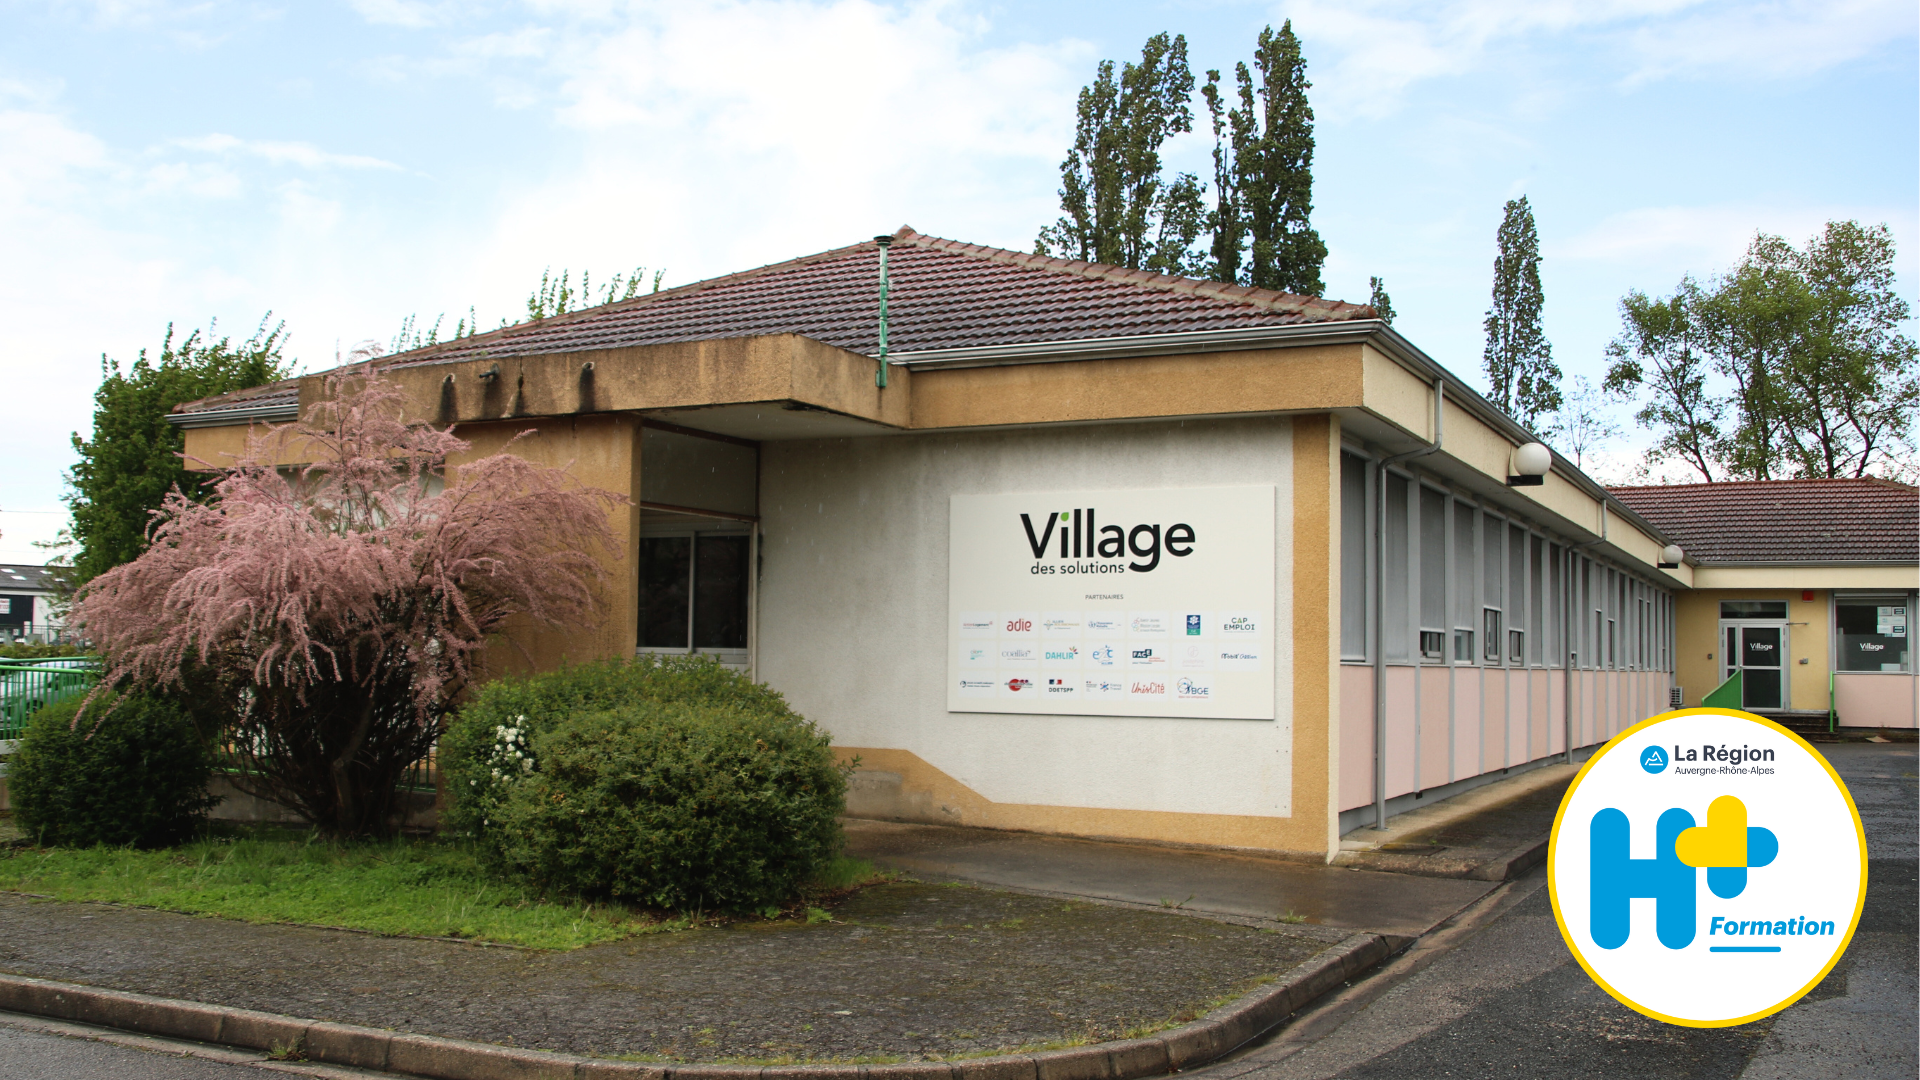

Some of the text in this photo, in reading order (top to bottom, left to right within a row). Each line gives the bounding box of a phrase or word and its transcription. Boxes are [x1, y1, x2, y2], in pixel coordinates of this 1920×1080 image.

[1019, 507, 1196, 573] Village
[1030, 560, 1125, 575] des solutions
[1006, 618, 1032, 632] adie
[1223, 623, 1256, 631] EMPLOI
[1749, 642, 1773, 651] Village
[1859, 642, 1884, 651] Village
[1045, 651, 1074, 660] DAHLIR
[1132, 649, 1152, 659] FACE
[1191, 687, 1209, 695] BGE
